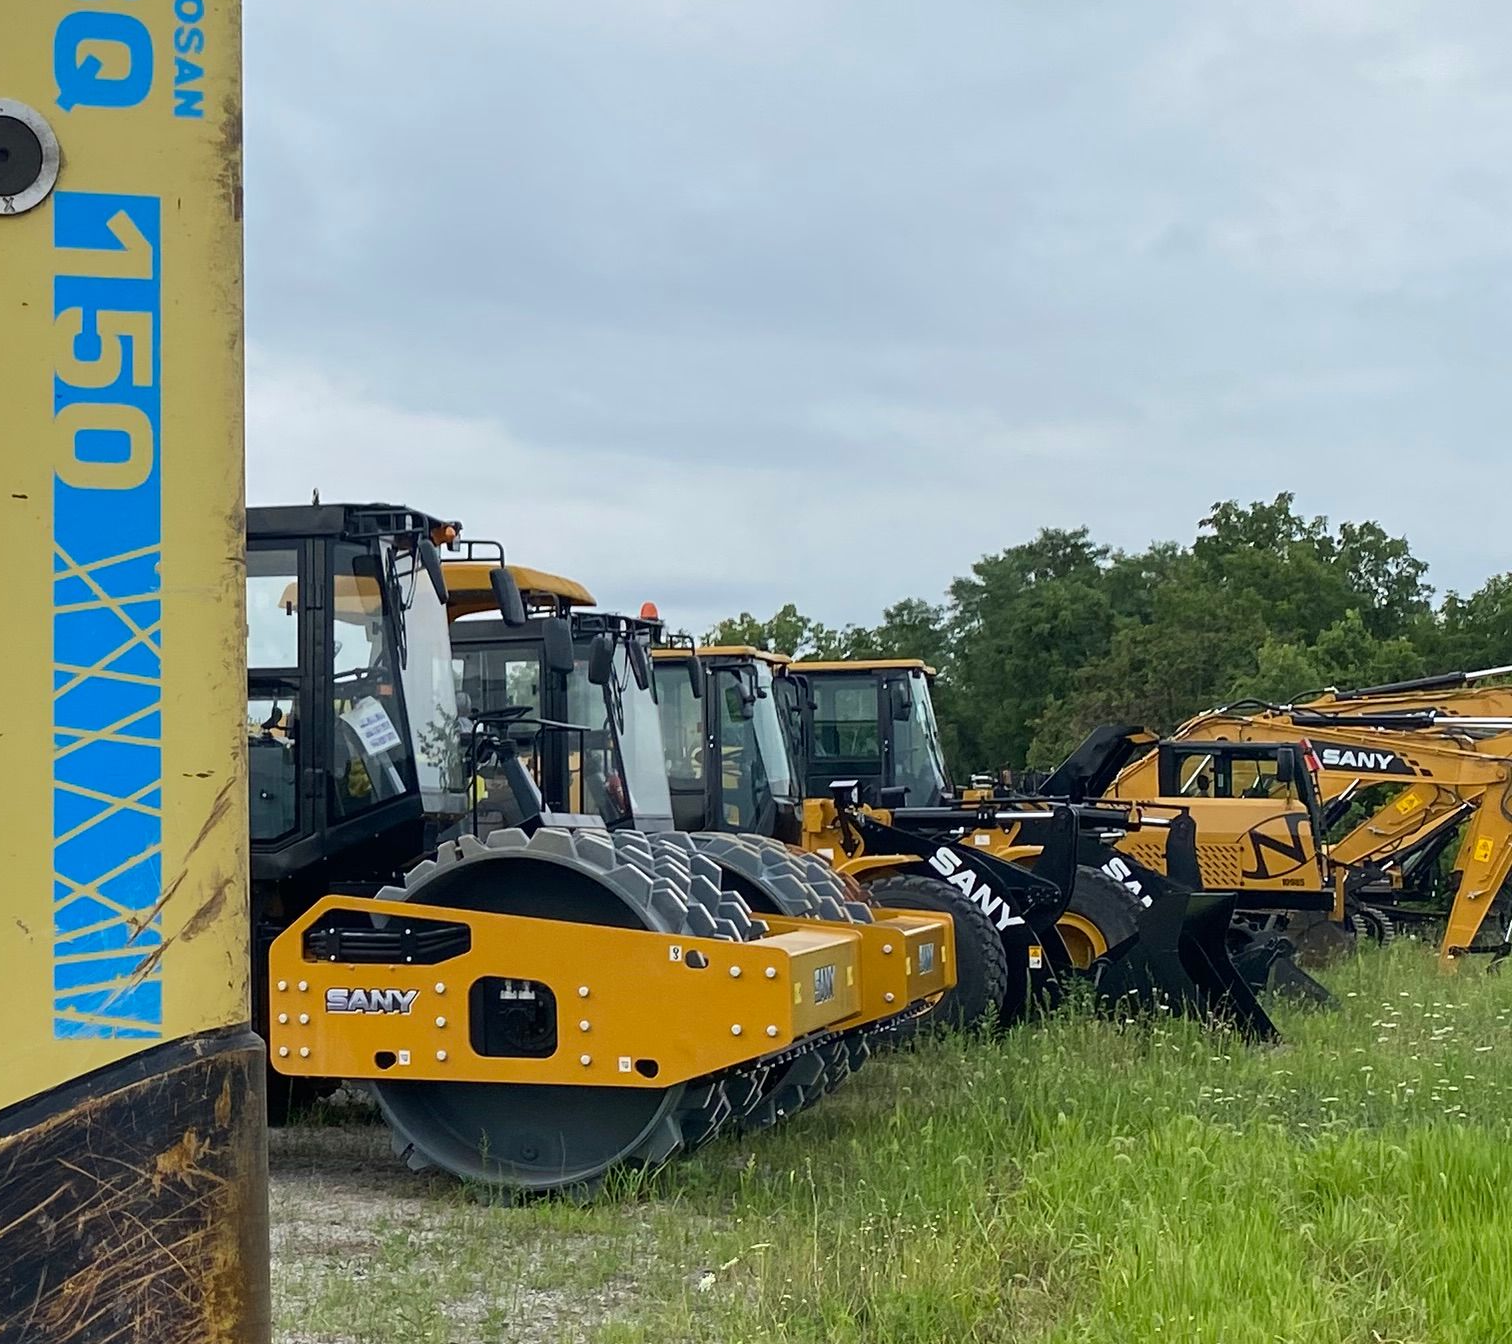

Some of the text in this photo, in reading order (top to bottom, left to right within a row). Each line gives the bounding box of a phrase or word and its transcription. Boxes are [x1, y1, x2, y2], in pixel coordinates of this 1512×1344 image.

[53, 209, 154, 491] 150
[1322, 748, 1395, 770] SANY
[928, 846, 1026, 932] SANY
[1101, 857, 1153, 908] SA
[325, 987, 420, 1013] SANY
